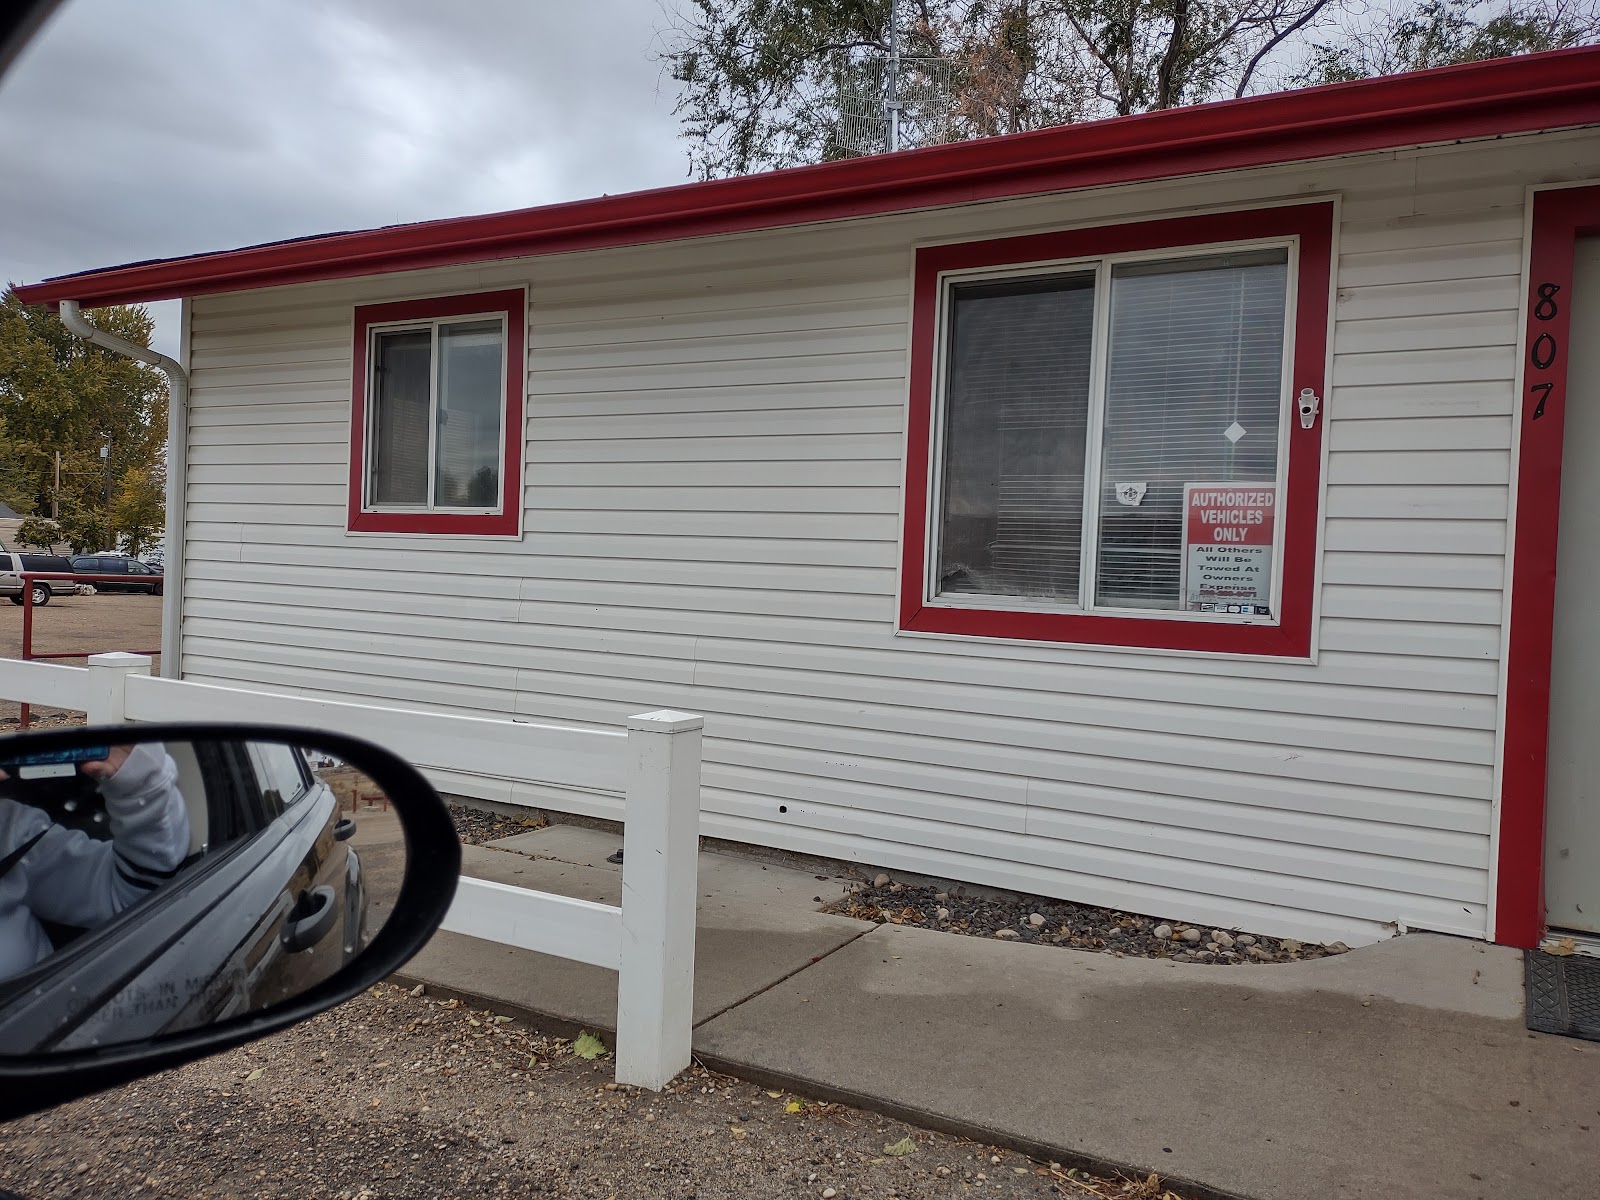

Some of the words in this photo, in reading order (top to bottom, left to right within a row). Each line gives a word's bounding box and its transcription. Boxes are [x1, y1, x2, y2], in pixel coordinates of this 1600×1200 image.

[1531, 283, 1560, 420] 807
[1191, 492, 1274, 507] AUTHORIZED
[1201, 509, 1263, 525] VEHICLES
[1213, 527, 1248, 542] ONLY
[1217, 546, 1263, 554] Others
[1202, 574, 1253, 582] Owners
[1200, 583, 1256, 591] Expense
